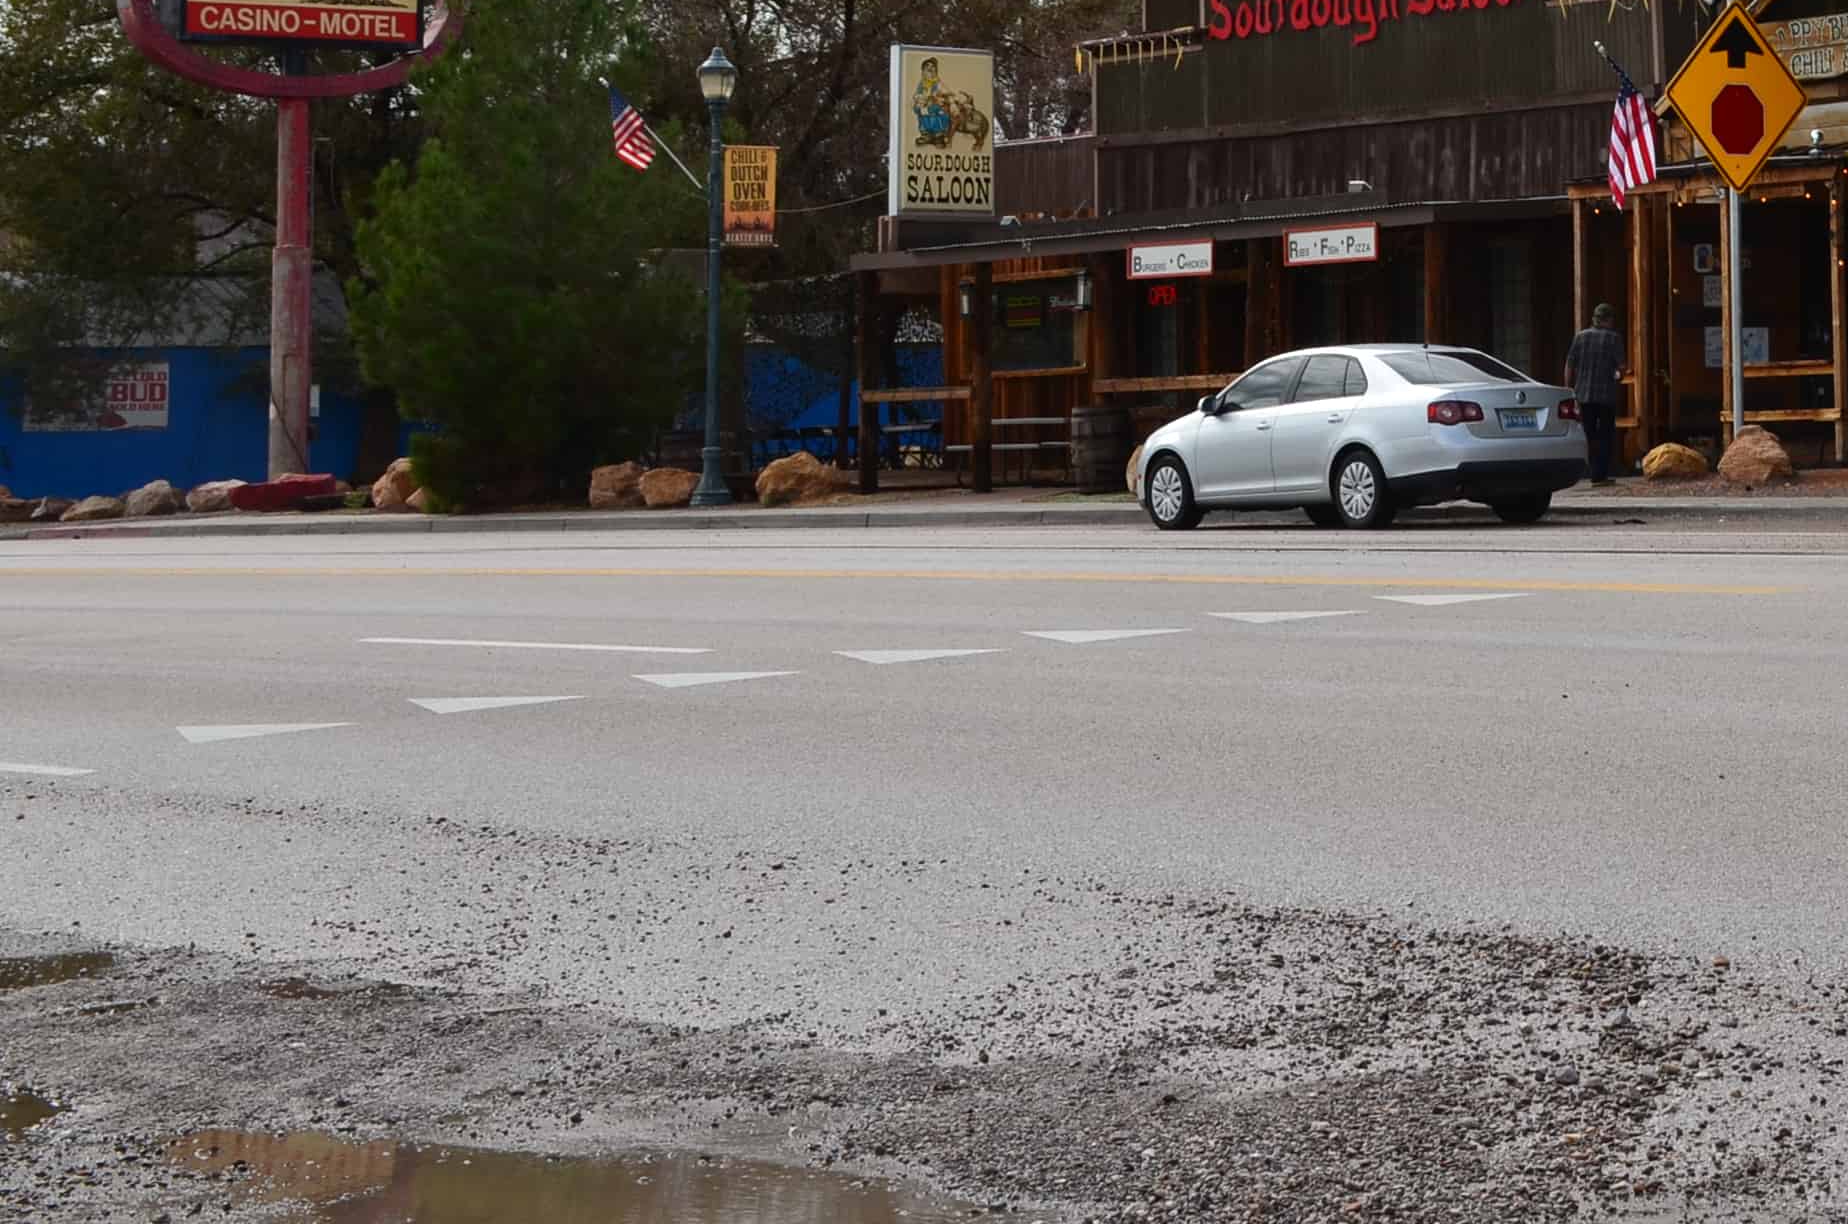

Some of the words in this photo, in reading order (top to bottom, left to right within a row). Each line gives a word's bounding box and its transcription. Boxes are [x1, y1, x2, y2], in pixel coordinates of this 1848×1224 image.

[1791, 48, 1833, 76] CHILI
[731, 150, 758, 164] CHILI
[907, 153, 990, 173] SOURDOUGH
[731, 166, 768, 181] DUTCH
[733, 183, 766, 200] OVEN
[907, 175, 991, 204] SALOON
[1346, 236, 1371, 253] PIZZA
[112, 382, 166, 402] BUD
